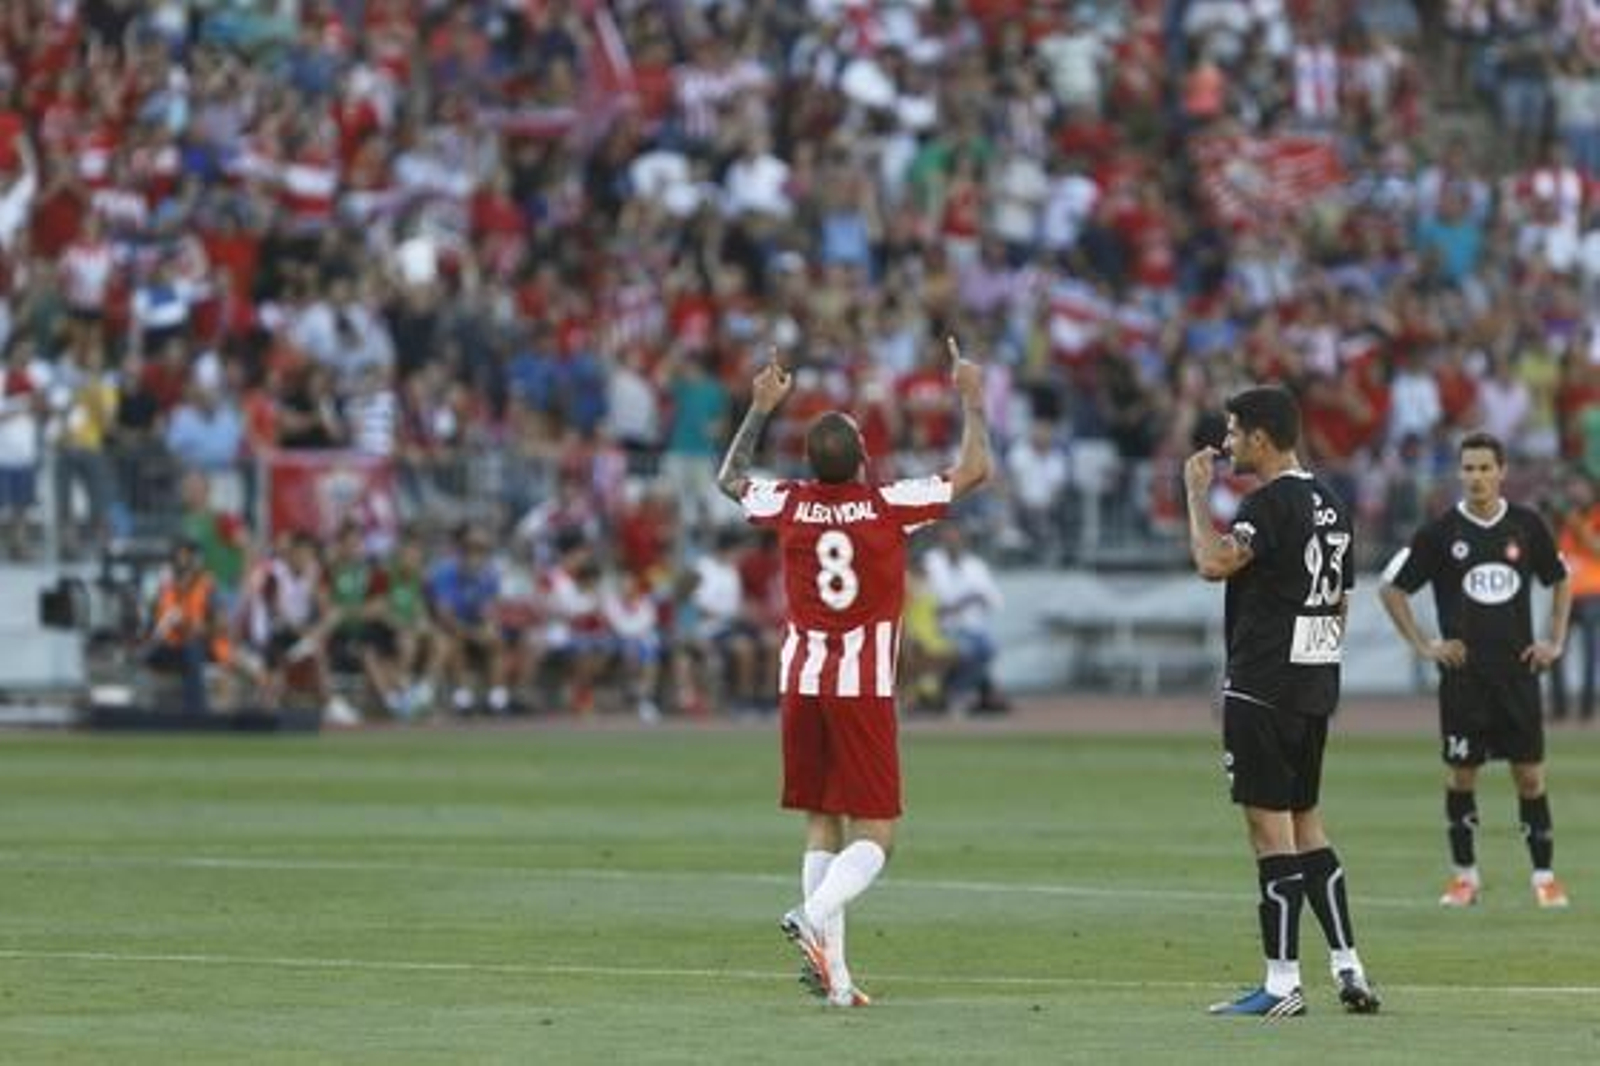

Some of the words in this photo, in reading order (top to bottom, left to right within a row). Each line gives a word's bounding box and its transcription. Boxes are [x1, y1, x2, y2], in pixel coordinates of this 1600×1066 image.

[832, 500, 878, 524] VIDAL
[815, 530, 859, 611] 8
[1470, 569, 1514, 595] RDI
